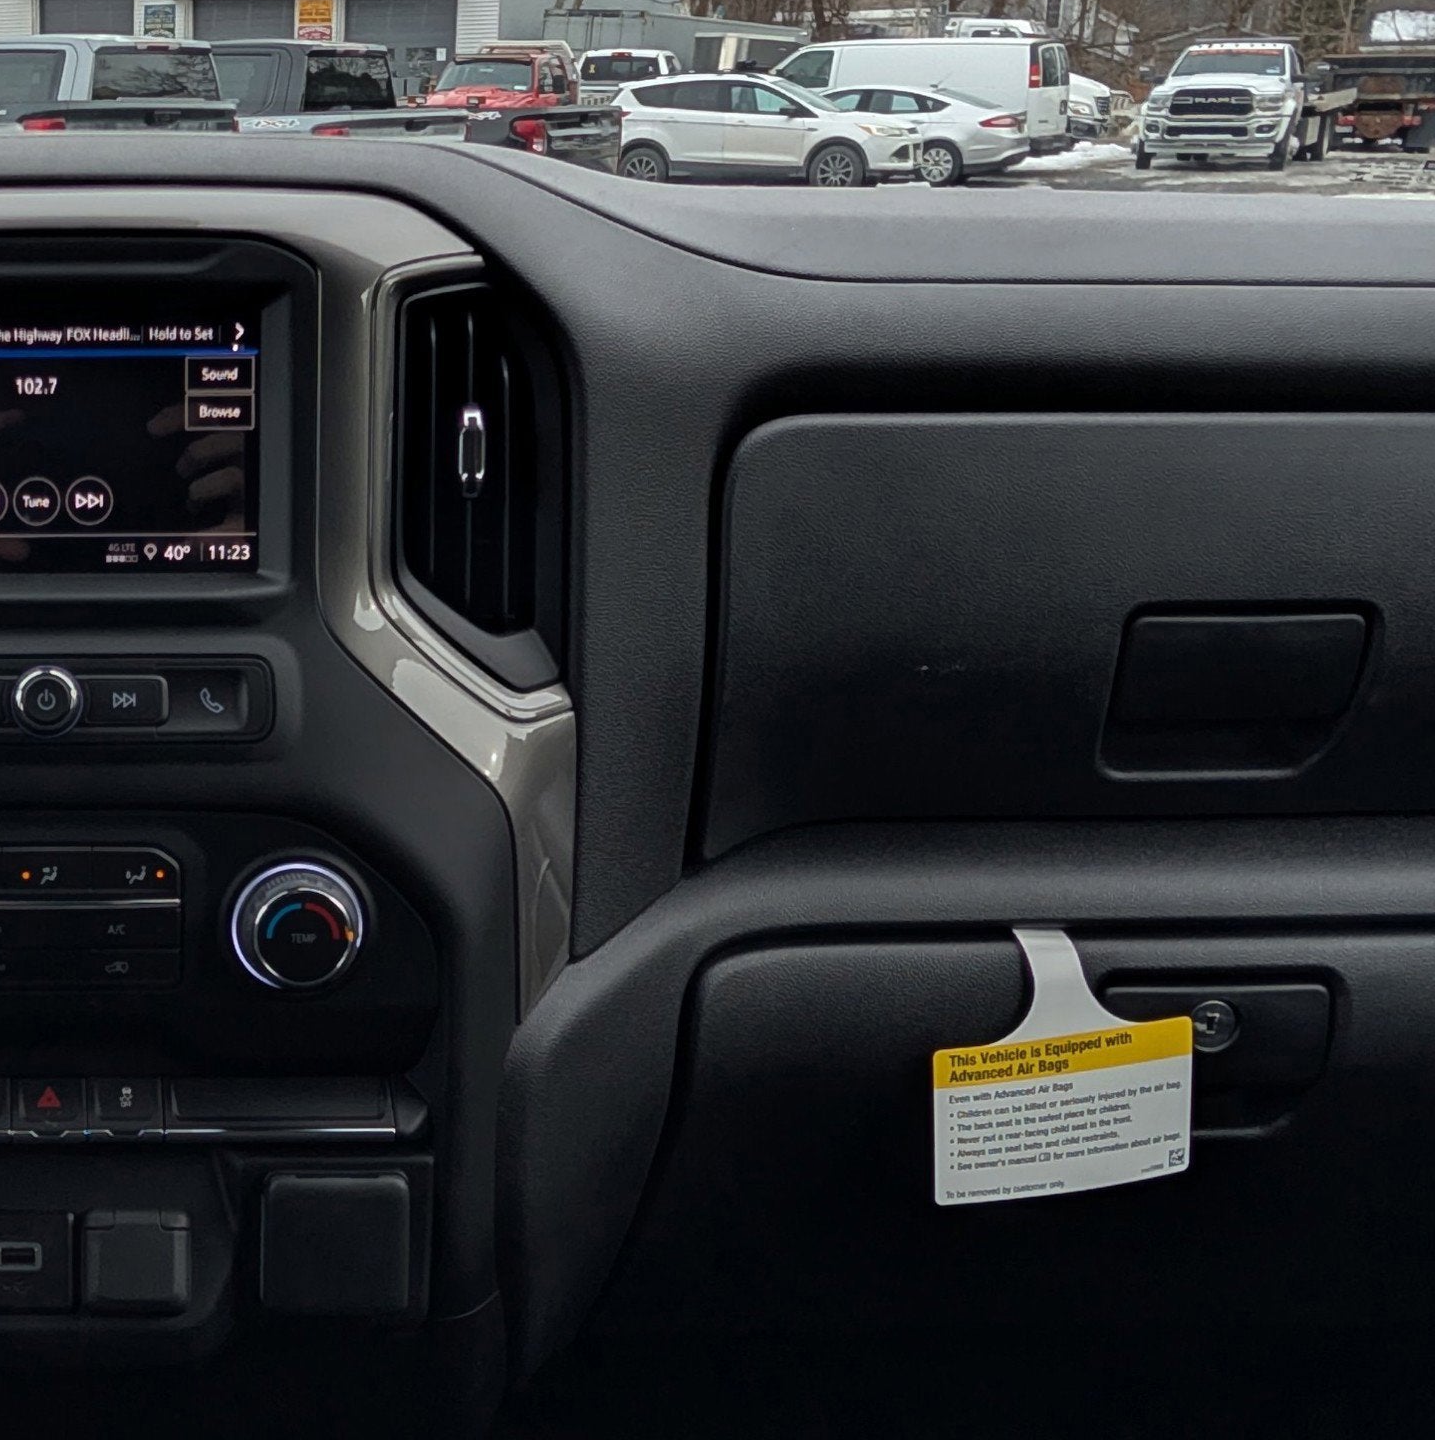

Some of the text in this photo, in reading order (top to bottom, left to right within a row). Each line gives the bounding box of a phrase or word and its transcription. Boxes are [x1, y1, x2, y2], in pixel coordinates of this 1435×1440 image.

[14, 328, 63, 344] Highway
[67, 328, 91, 341] FOX
[149, 328, 213, 341] Hold to Set
[201, 367, 238, 381] Sound
[15, 377, 58, 395] 102.7
[199, 405, 241, 418] Browse
[22, 495, 50, 508] Tune
[108, 543, 136, 552] 4G LTE
[209, 545, 250, 561] 11:23
[107, 924, 126, 935] A/C
[290, 933, 318, 944] TEMP
[949, 1054, 976, 1067] This
[980, 1048, 1027, 1064] Vehicle
[1045, 1037, 1101, 1055] Equipped
[1105, 1032, 1132, 1046] with
[950, 1059, 1069, 1082] Advanced Air Bags
[949, 1083, 1073, 1104] Even with Advanced Air Bags
[957, 1108, 992, 1119] Children
[1012, 1105, 1021, 1113] be
[1025, 1102, 1046, 1111] killed
[1060, 1095, 1095, 1106] seriously
[1098, 1090, 1125, 1101] injured
[1128, 1089, 1137, 1097] by
[1154, 1084, 1164, 1092] air
[957, 1124, 972, 1132] The
[974, 1122, 993, 1130] back
[1038, 1114, 1061, 1122] safest
[1064, 1111, 1084, 1120] place
[983, 1135, 996, 1143] put
[1005, 1129, 1048, 1139] rear-facing
[1051, 1125, 1069, 1134] child
[1072, 1122, 1087, 1131] seat
[957, 1149, 985, 1158] Always
[1061, 1137, 1080, 1145] child
[1008, 1155, 1036, 1165] manual
[1053, 1152, 1063, 1160] for
[1066, 1150, 1085, 1158] more
[1087, 1143, 1128, 1155] information
[1131, 1138, 1151, 1148] about
[968, 1187, 1000, 1197] removed
[1013, 1183, 1047, 1192] customer
